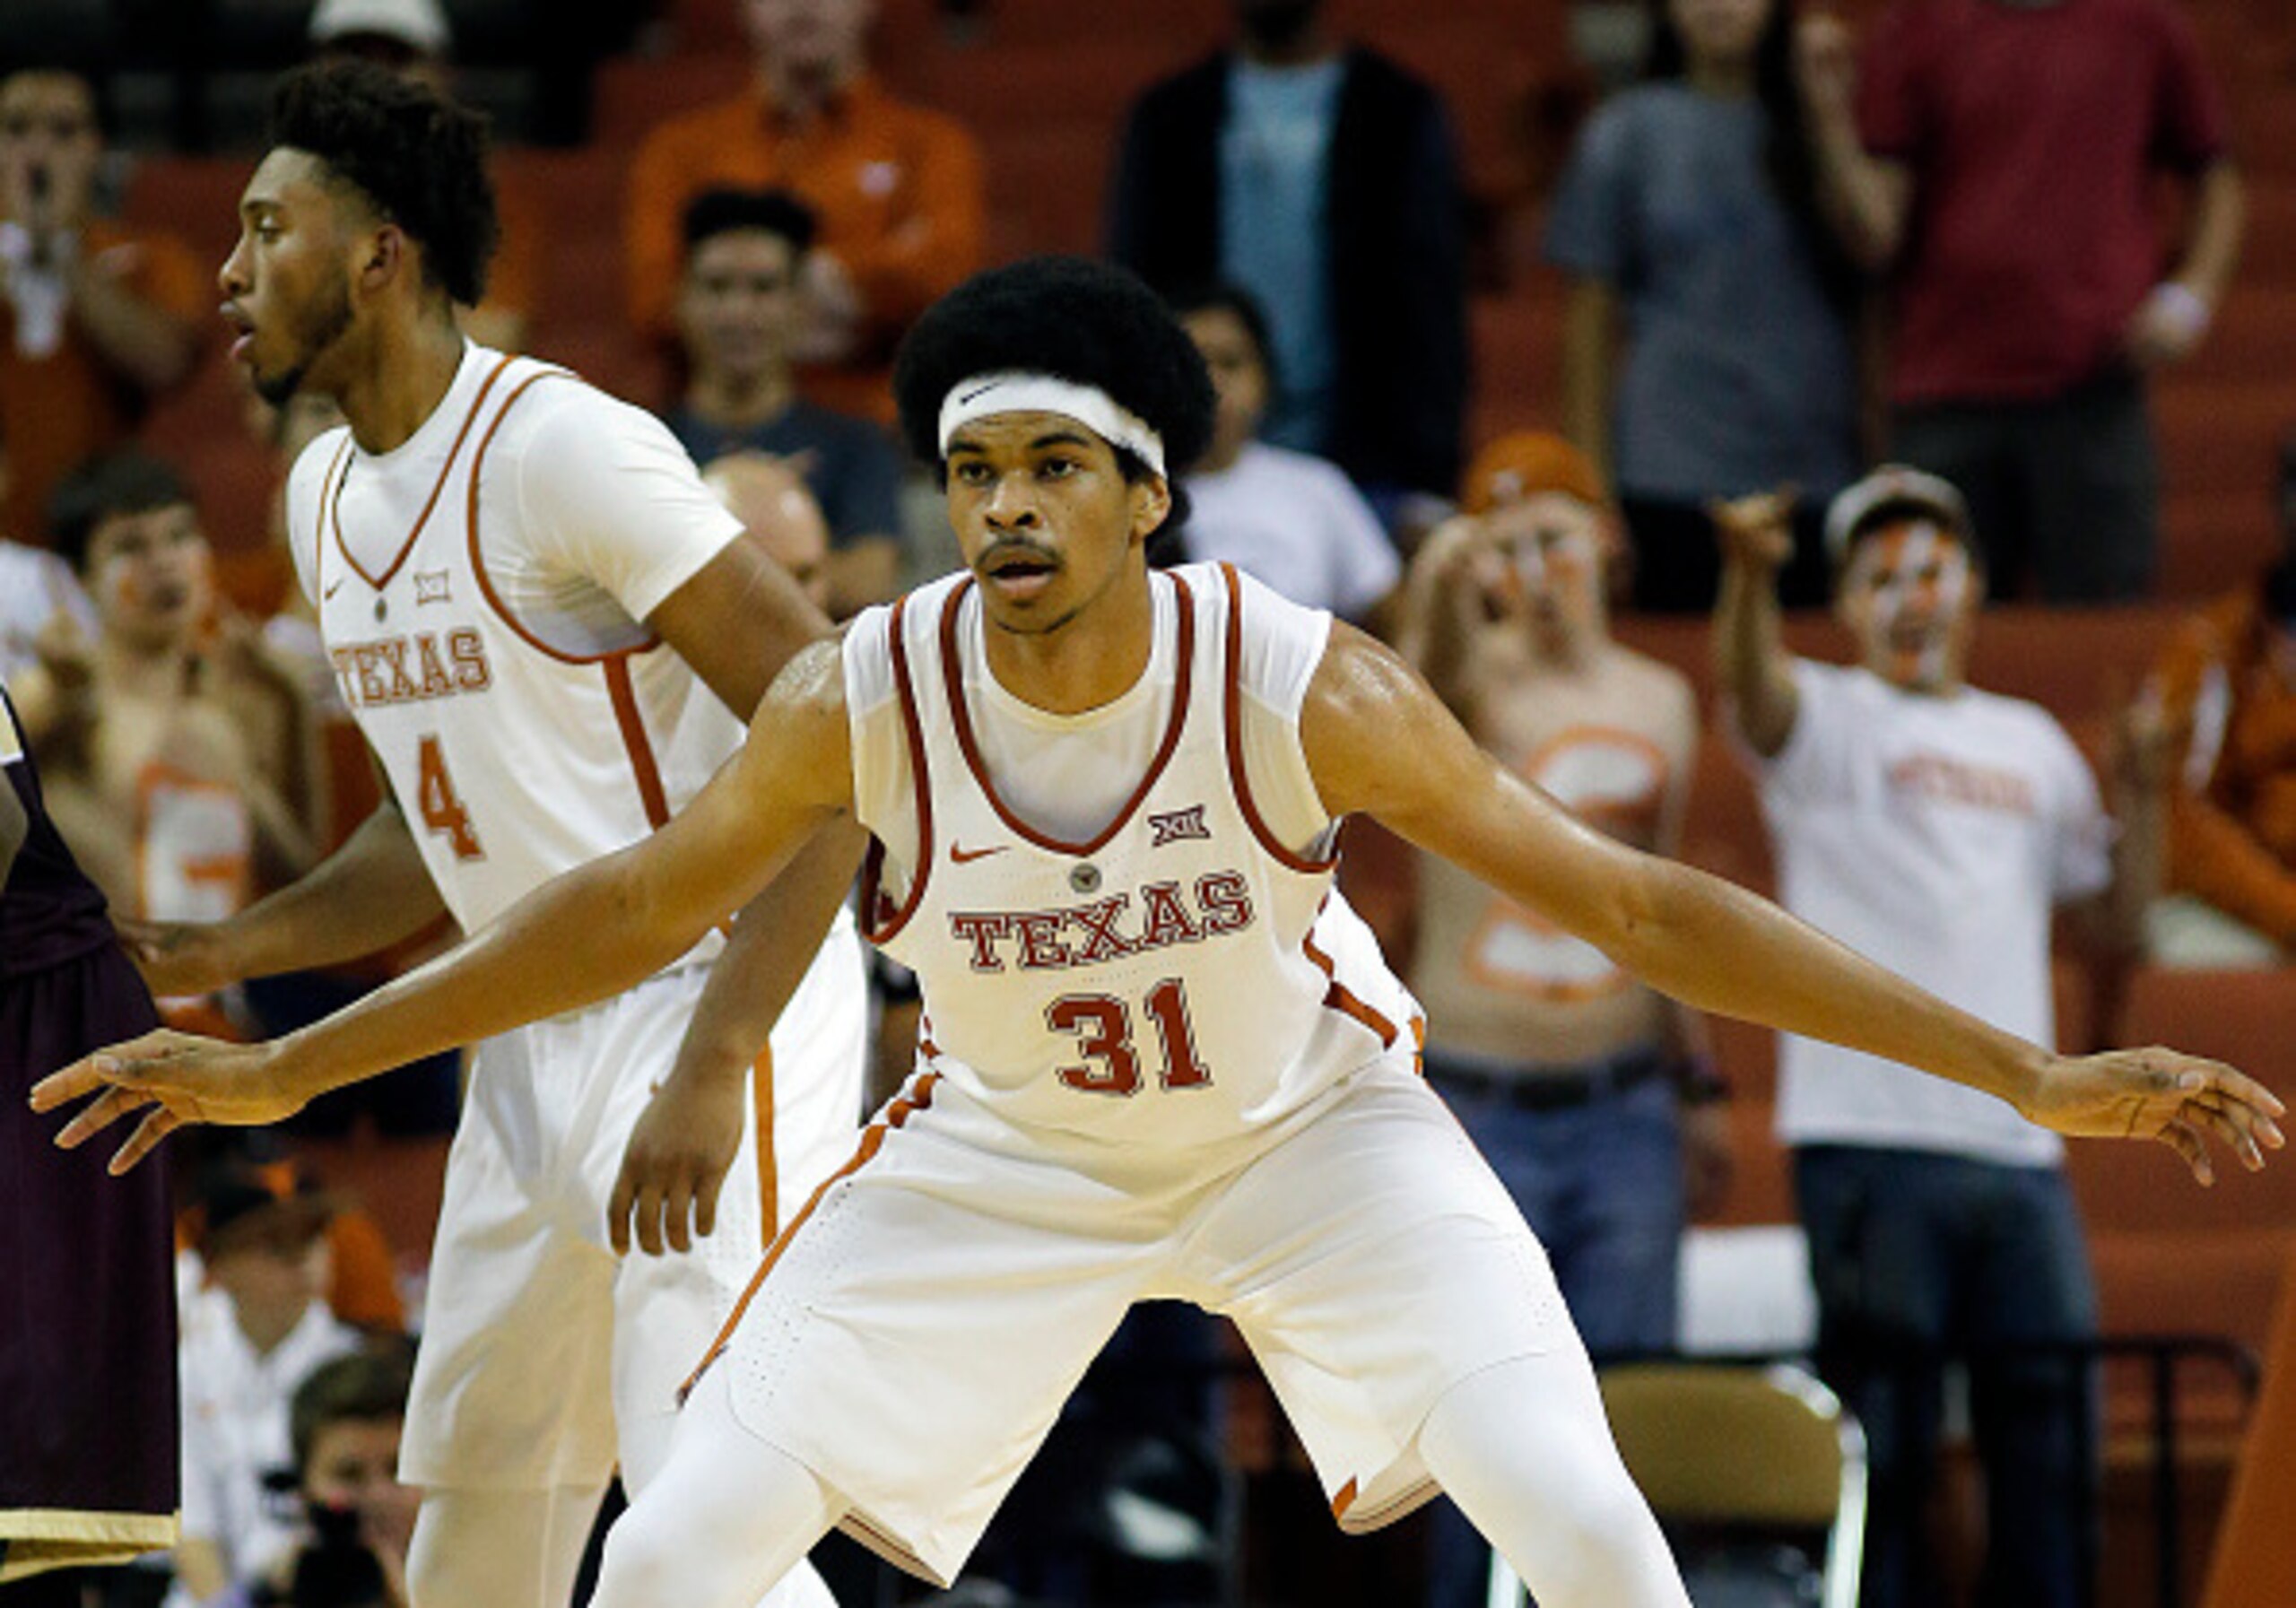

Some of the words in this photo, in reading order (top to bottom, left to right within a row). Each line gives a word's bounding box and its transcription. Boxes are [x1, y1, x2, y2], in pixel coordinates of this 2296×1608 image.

[332, 630, 491, 708] TEXAS
[417, 733, 485, 861] 4
[948, 869, 1255, 972] TEXAS
[1044, 978, 1213, 1097] 31
